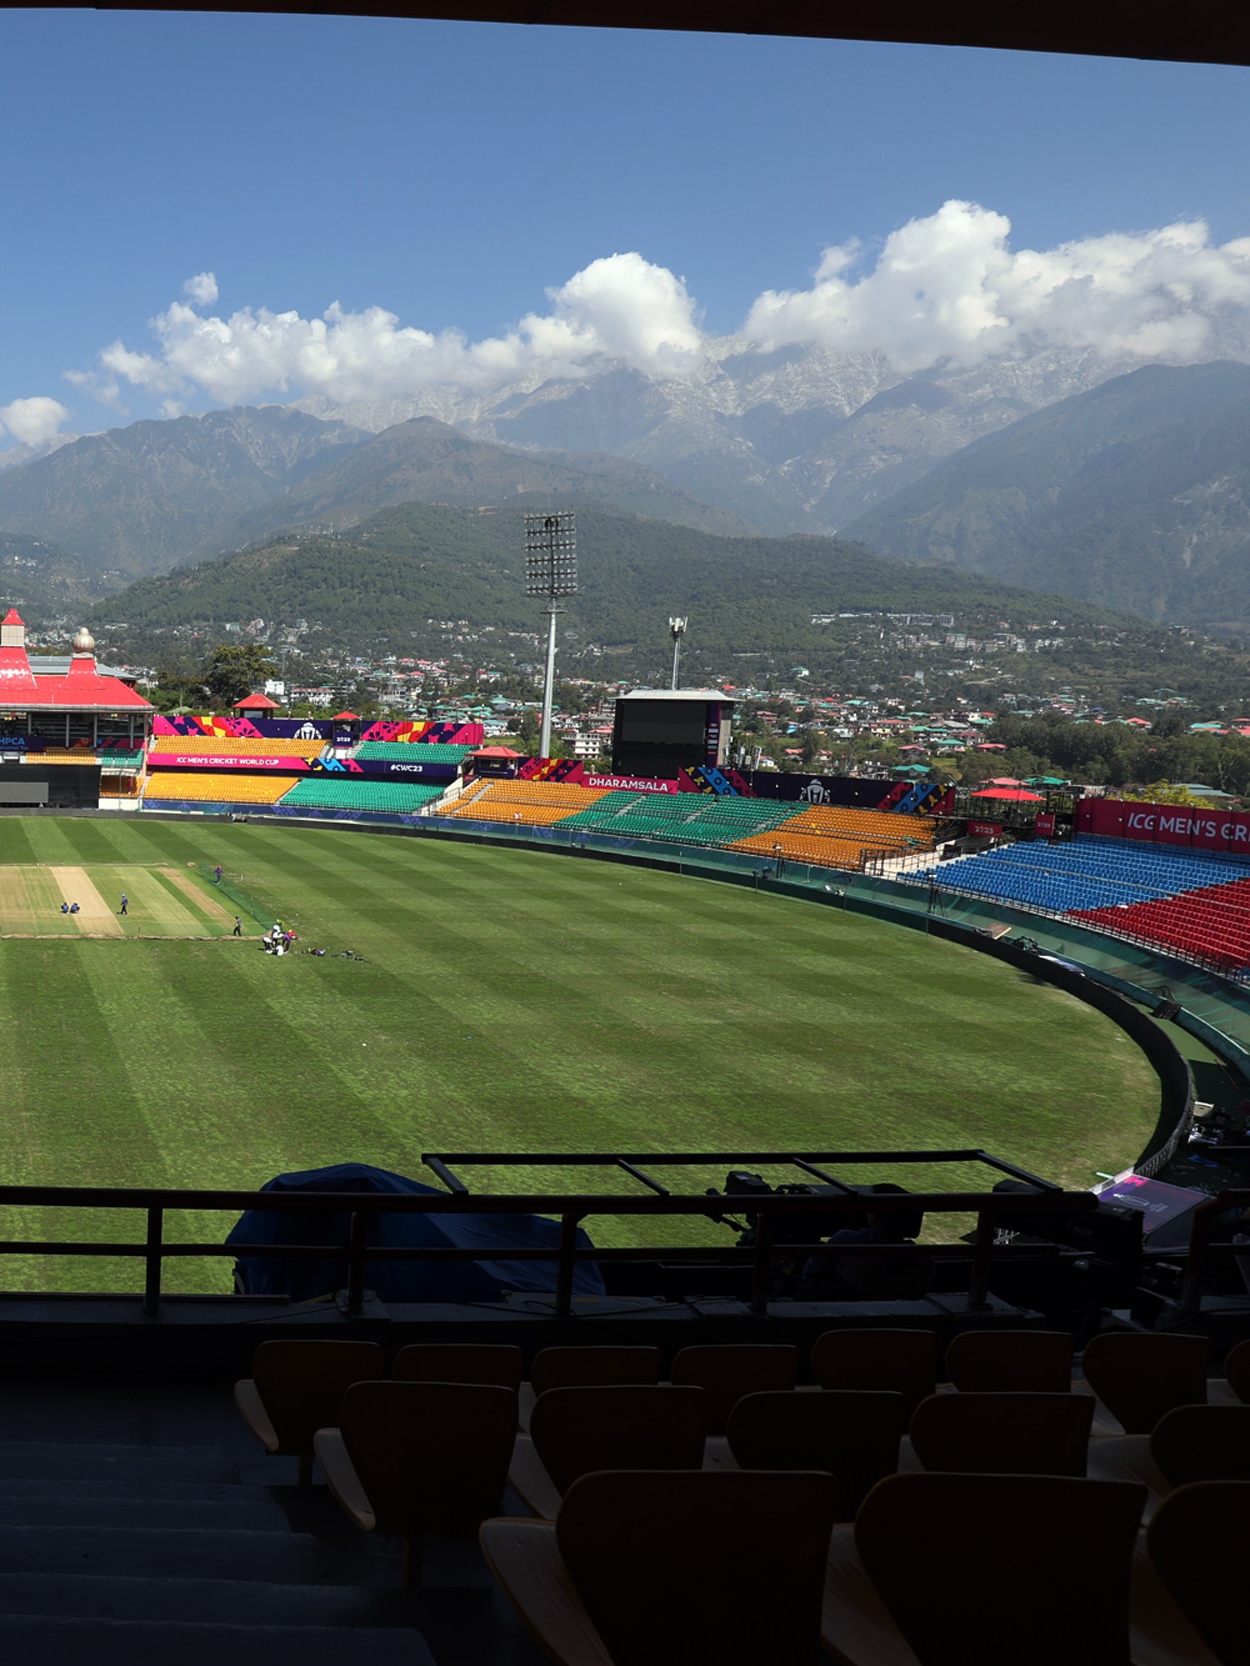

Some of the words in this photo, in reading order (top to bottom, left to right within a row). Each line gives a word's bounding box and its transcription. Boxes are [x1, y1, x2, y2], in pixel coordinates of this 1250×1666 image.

[391, 764, 423, 772] #CWC23
[589, 777, 668, 792] DHARAMSALA
[1128, 813, 1155, 830] ICC
[1159, 816, 1216, 838] MEN'S
